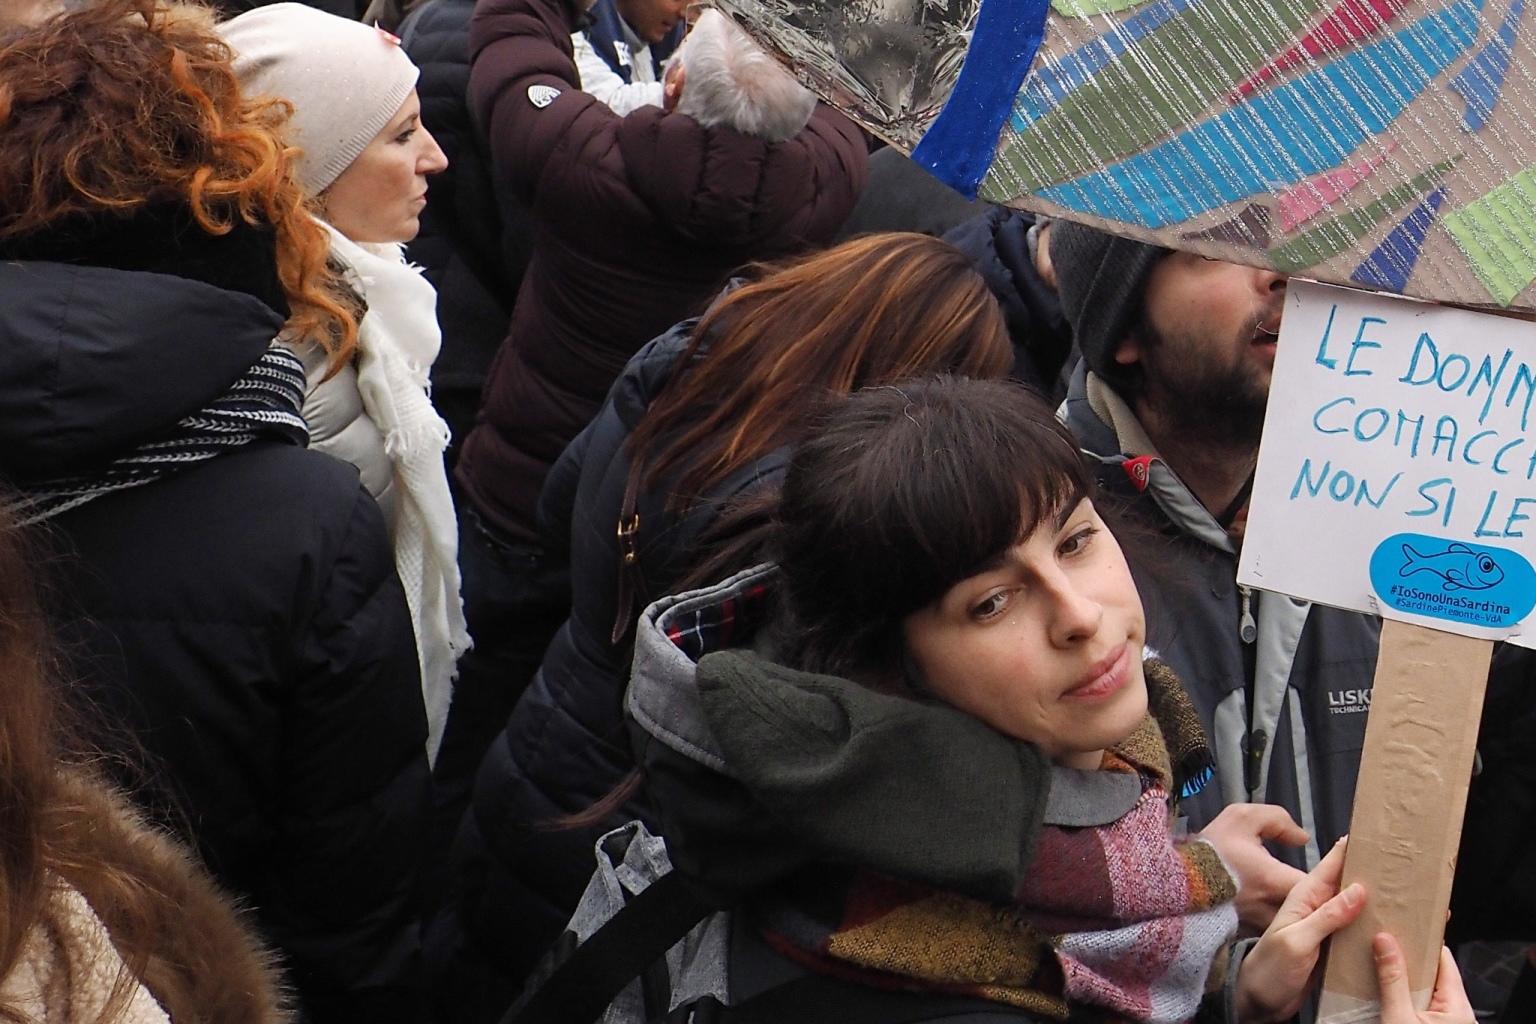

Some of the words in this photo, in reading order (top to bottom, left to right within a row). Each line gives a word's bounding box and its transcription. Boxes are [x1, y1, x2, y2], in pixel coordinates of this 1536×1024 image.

[1315, 305, 1386, 376] LE
[1290, 459, 1405, 508] NON
[1405, 479, 1457, 527] SI
[1390, 584, 1511, 615] #IoSonoUnaSardina
[1329, 705, 1370, 714] TECHNICA
